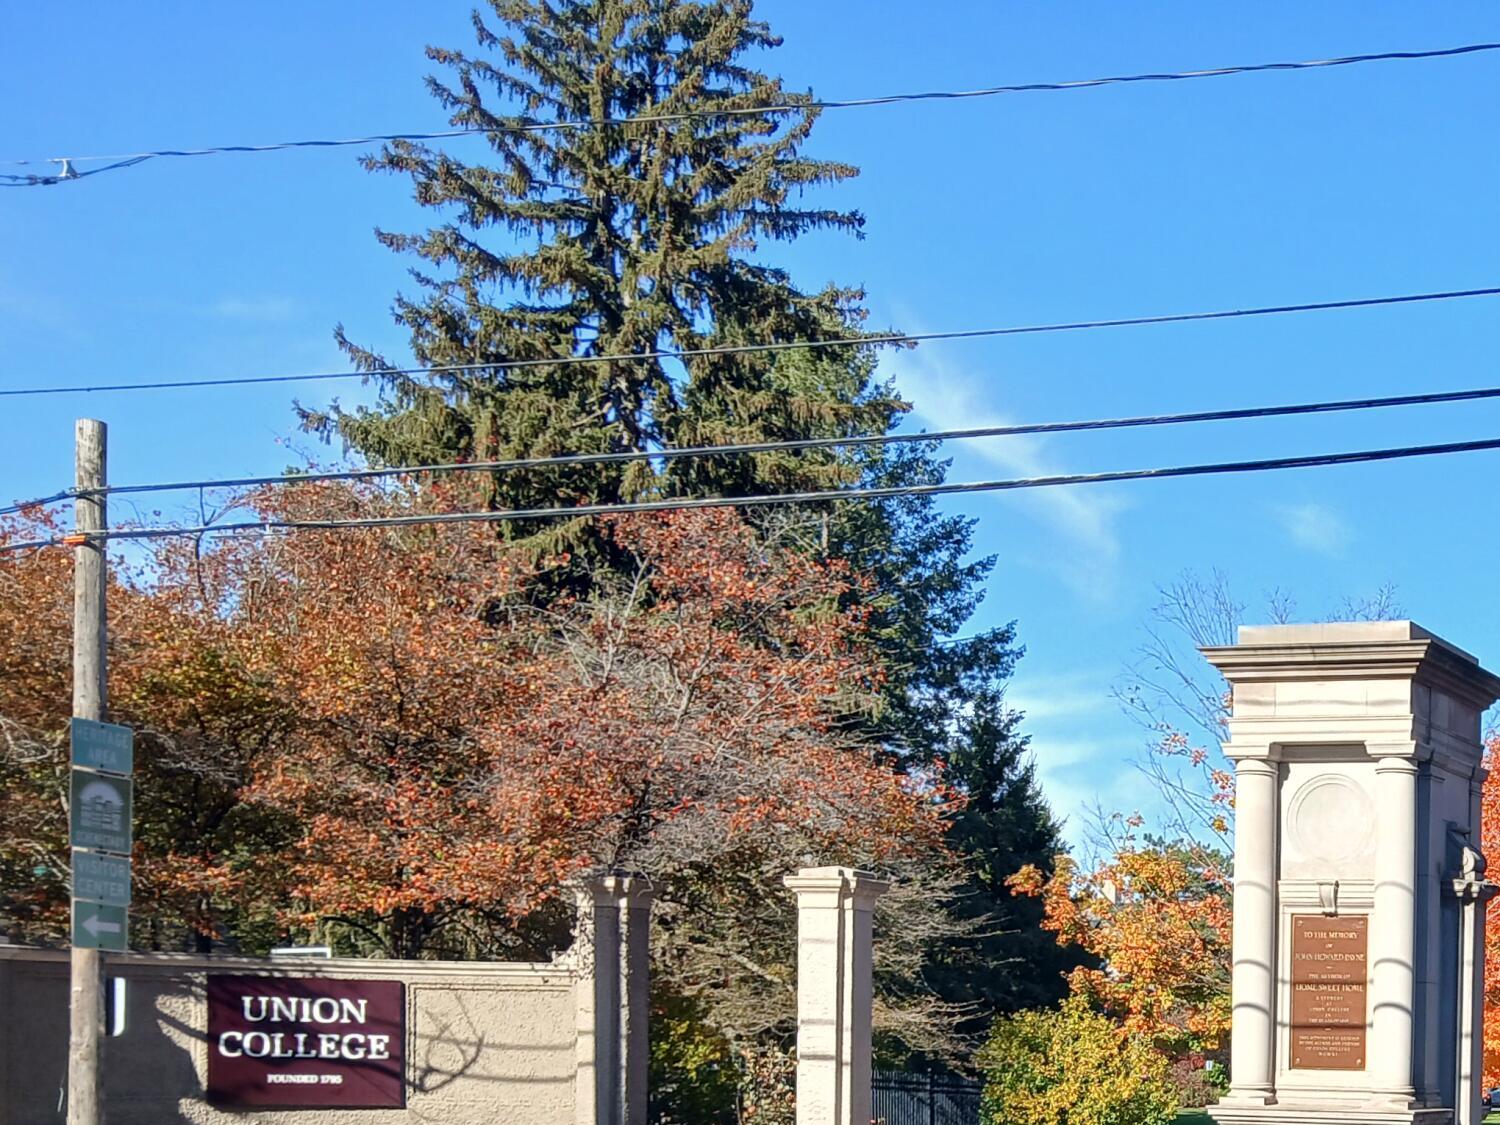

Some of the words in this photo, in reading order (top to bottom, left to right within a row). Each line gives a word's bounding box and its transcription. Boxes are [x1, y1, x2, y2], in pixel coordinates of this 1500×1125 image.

[88, 748, 117, 764] AREA
[76, 859, 126, 878] VISITOR
[77, 878, 125, 897] CENTER
[241, 995, 368, 1024] UNION
[218, 1031, 390, 1060] COLLEGE
[266, 1074, 319, 1085] FOUNDED
